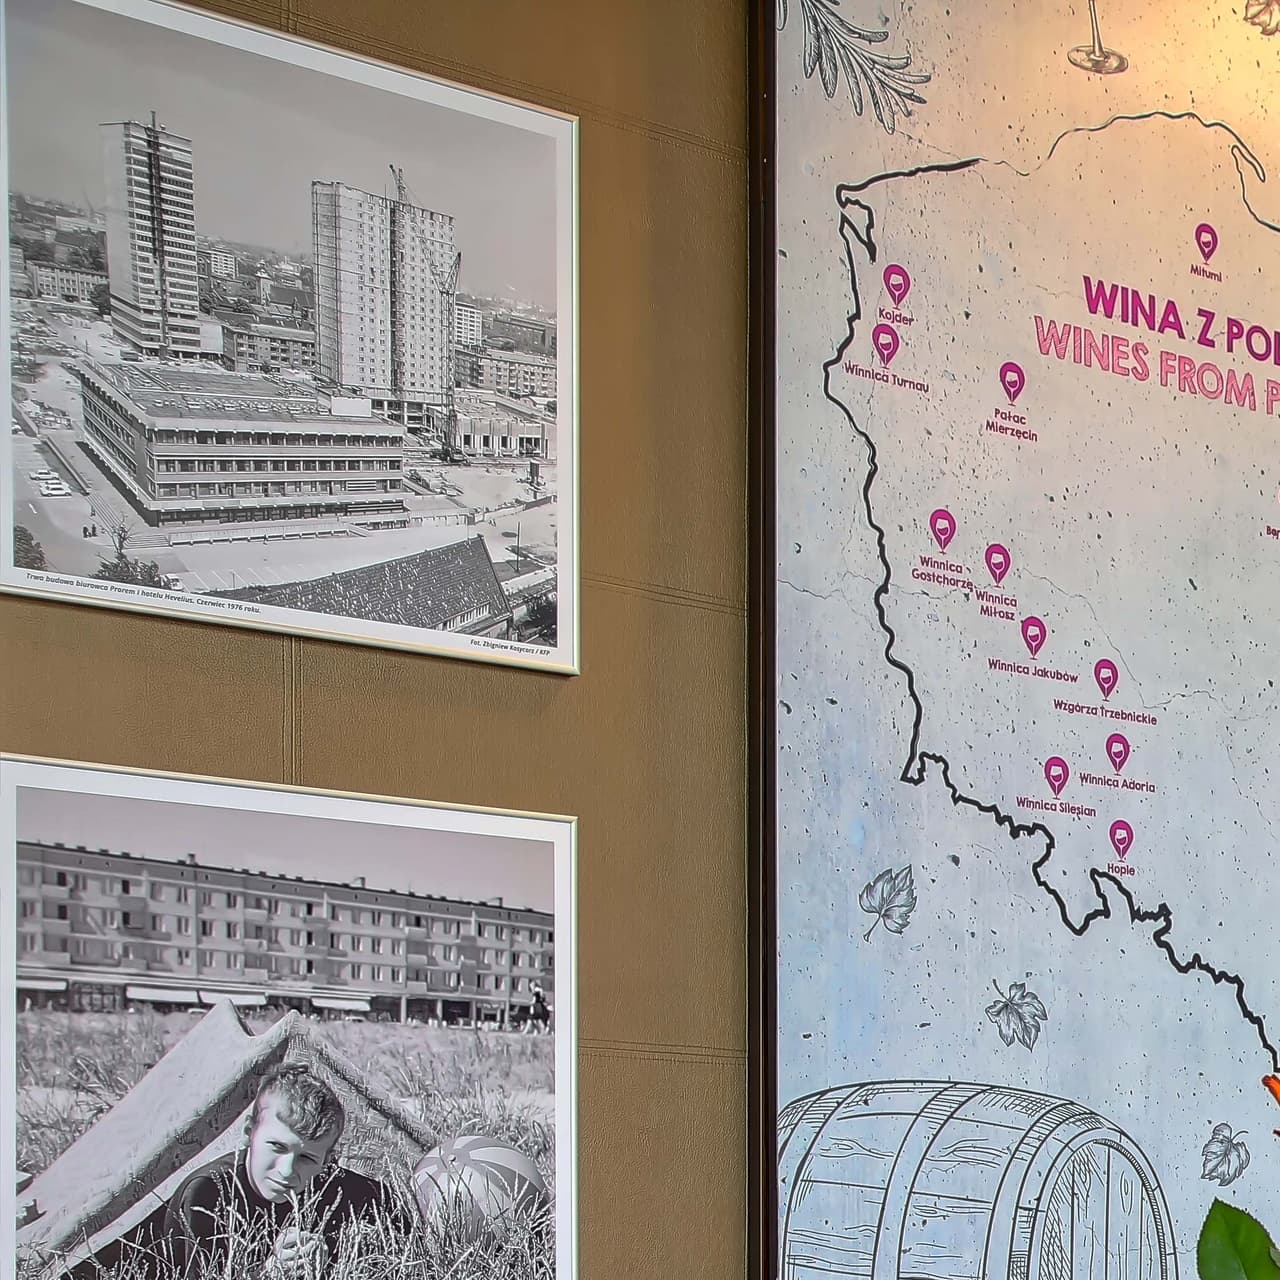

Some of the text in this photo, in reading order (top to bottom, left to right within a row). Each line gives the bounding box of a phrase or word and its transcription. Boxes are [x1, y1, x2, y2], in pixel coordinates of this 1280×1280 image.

[1190, 264, 1222, 282] Mitumi
[878, 308, 914, 326] Kojder
[1083, 275, 1185, 339] WINA
[1197, 307, 1216, 348] Z
[1034, 315, 1150, 382] WINES
[1159, 350, 1257, 411] FROM
[844, 361, 930, 393] Winnica Turnau
[994, 408, 1027, 425] Pałac
[985, 420, 1038, 442] Mierzęcin
[919, 555, 963, 574] Winnica
[26, 572, 45, 581] Trwa
[45, 575, 74, 586] budowa
[75, 580, 109, 591] biurowca
[140, 589, 164, 599] hotelu
[164, 593, 195, 604] Hevelius.
[196, 598, 226, 609] Czerwiec
[227, 602, 243, 611] 1976
[975, 589, 1018, 607] Winnica
[980, 604, 1016, 621] Miłosz
[988, 657, 1079, 683] Winnica Jakubów
[1053, 698, 1158, 726] Wzgórza Trzebnickie
[1079, 772, 1156, 793] Winnica Adoria
[1016, 796, 1096, 817] Winnica Silesian
[1107, 863, 1136, 876] Hople
